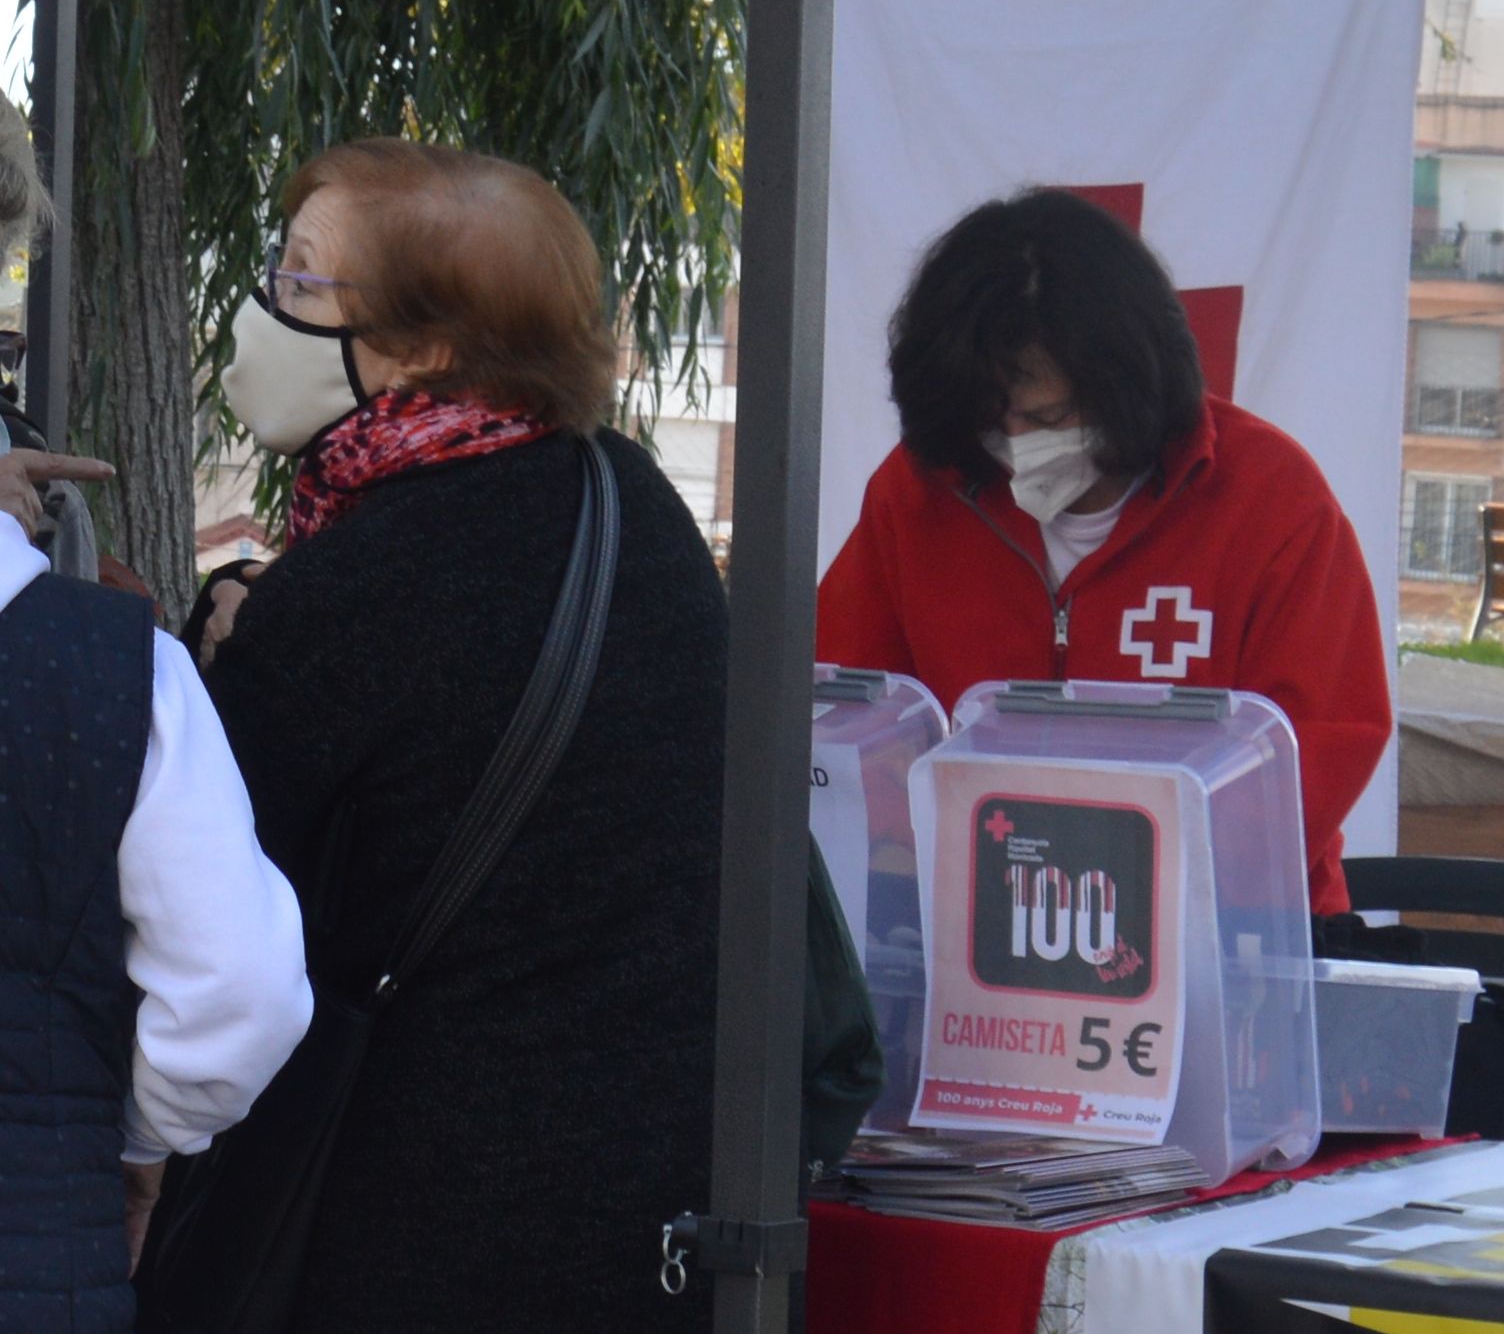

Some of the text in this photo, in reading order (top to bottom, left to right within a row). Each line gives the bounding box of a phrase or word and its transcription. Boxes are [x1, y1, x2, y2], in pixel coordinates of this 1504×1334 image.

[1004, 864, 1117, 965] 100
[942, 1012, 1163, 1078] CAMISETA 5 €
[936, 1091, 1064, 1116] 100 anys Creu Roja
[1103, 1109, 1163, 1125] Creu Roja
